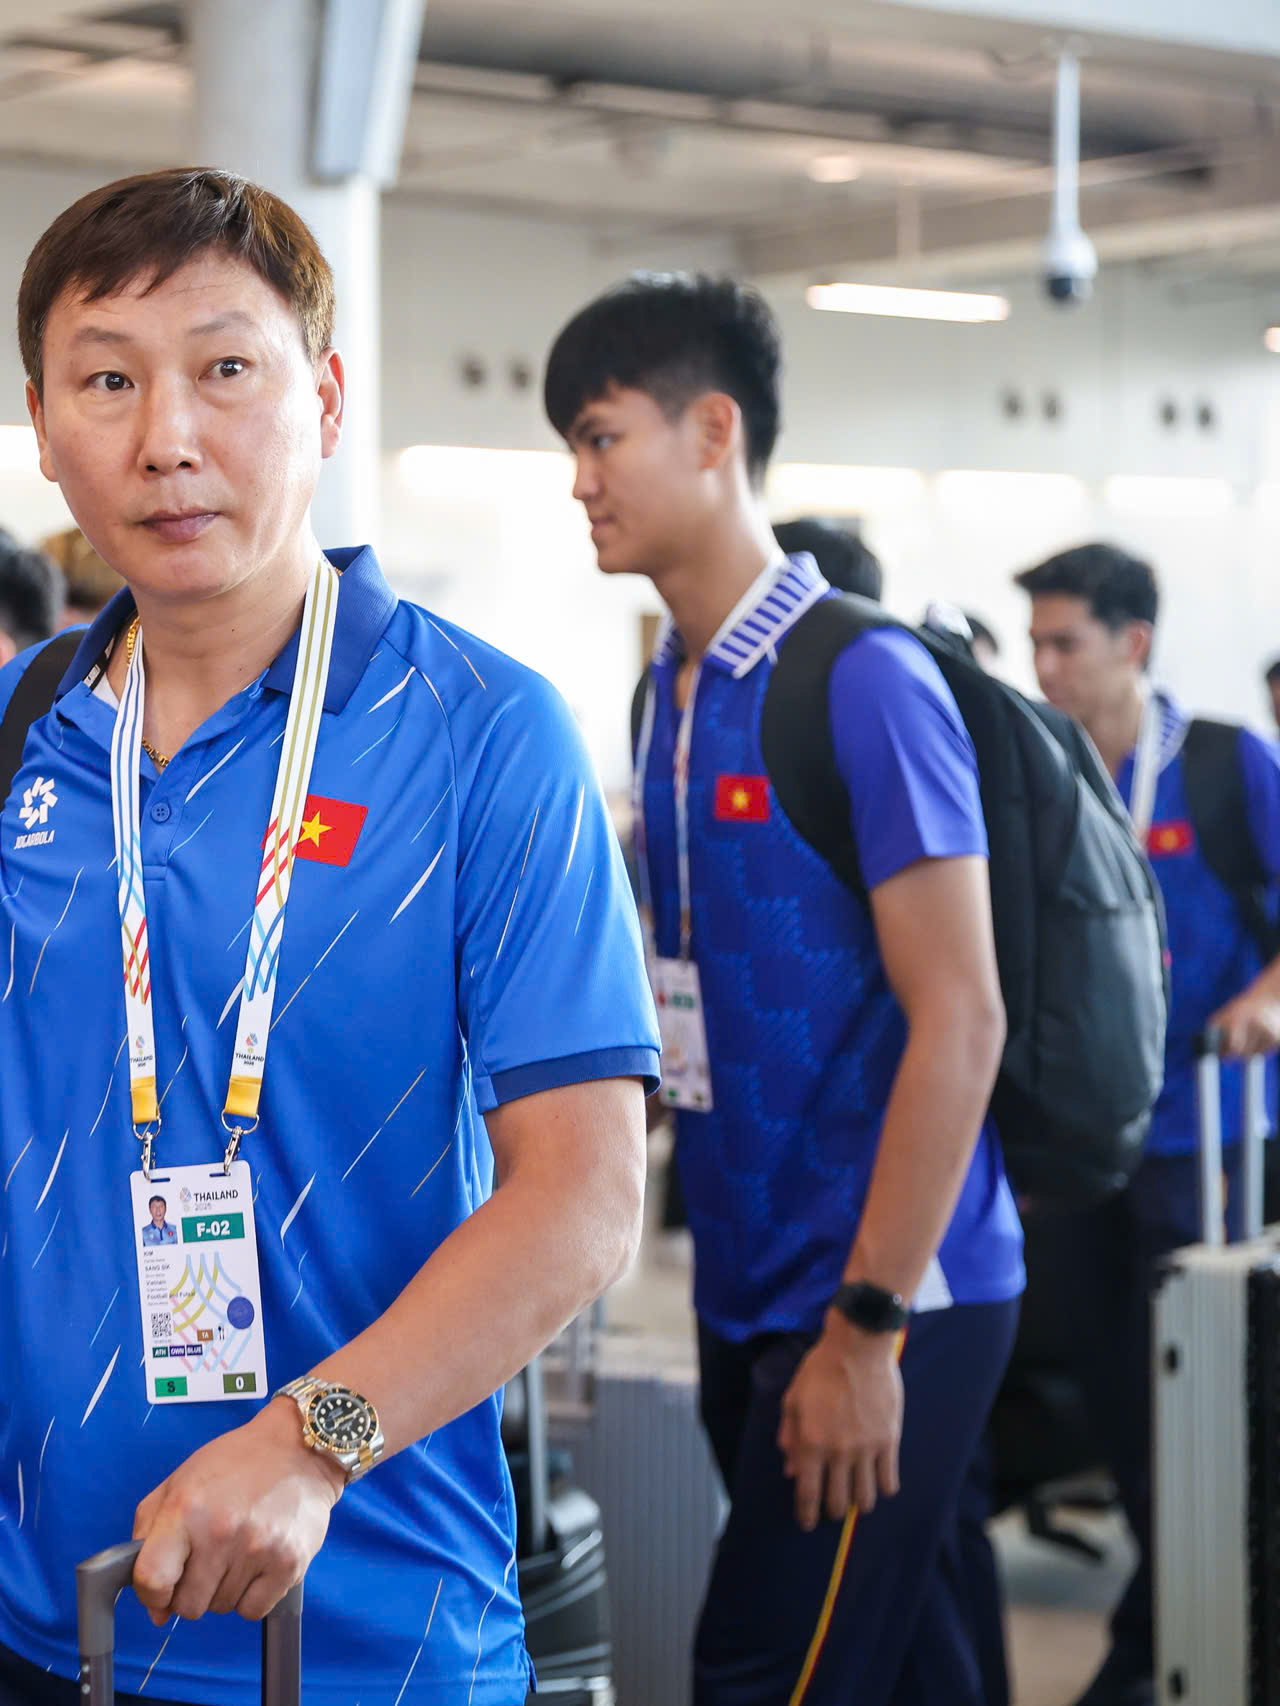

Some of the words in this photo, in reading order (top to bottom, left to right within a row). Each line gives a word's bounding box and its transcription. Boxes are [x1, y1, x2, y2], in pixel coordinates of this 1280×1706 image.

[235, 1052, 264, 1062] THAILAND
[193, 1189, 239, 1203] THAILAND
[196, 1220, 231, 1238] F-02
[167, 1381, 176, 1393] S
